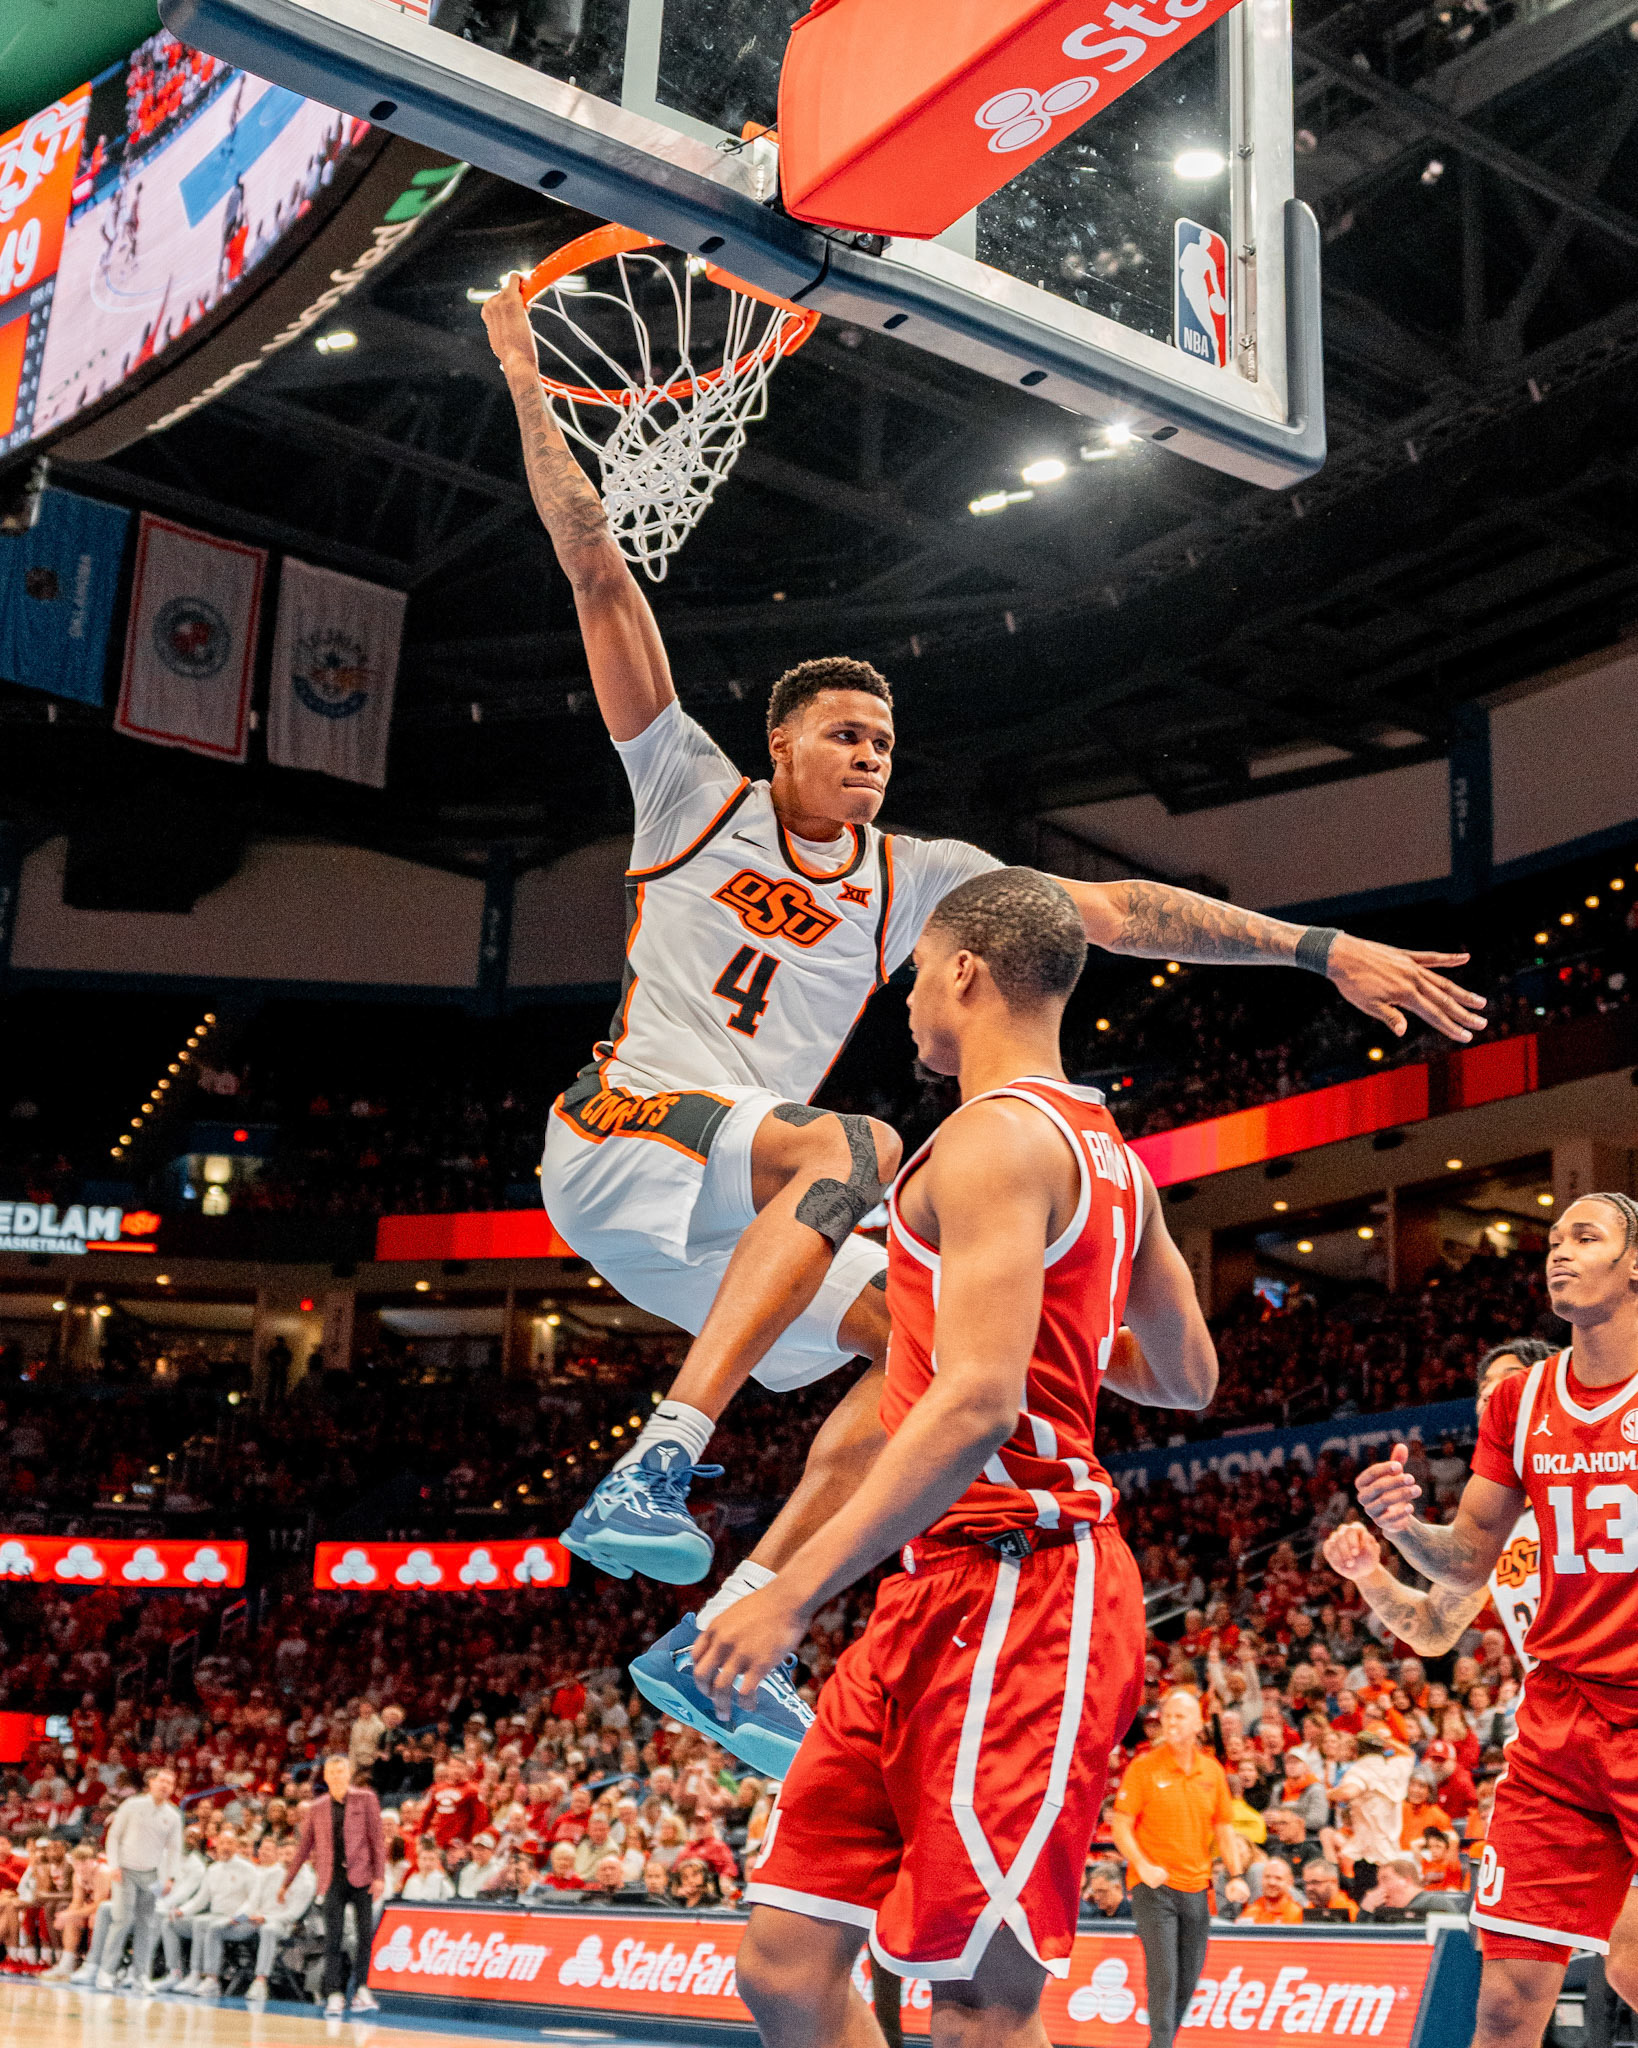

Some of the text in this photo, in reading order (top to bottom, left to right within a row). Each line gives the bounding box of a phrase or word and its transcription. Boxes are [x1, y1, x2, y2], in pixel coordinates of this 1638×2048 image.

[1183, 326, 1209, 358] NBA
[711, 869, 843, 949] OSU
[712, 943, 781, 1038] 4
[1098, 1205, 1126, 1370] 1
[1532, 1449, 1638, 1475] OKLAHOM
[1548, 1484, 1638, 1575] 13
[1477, 1845, 1505, 1907] OU
[409, 1927, 548, 1982] StateFarm
[1135, 1966, 1396, 2036] ateFarm
